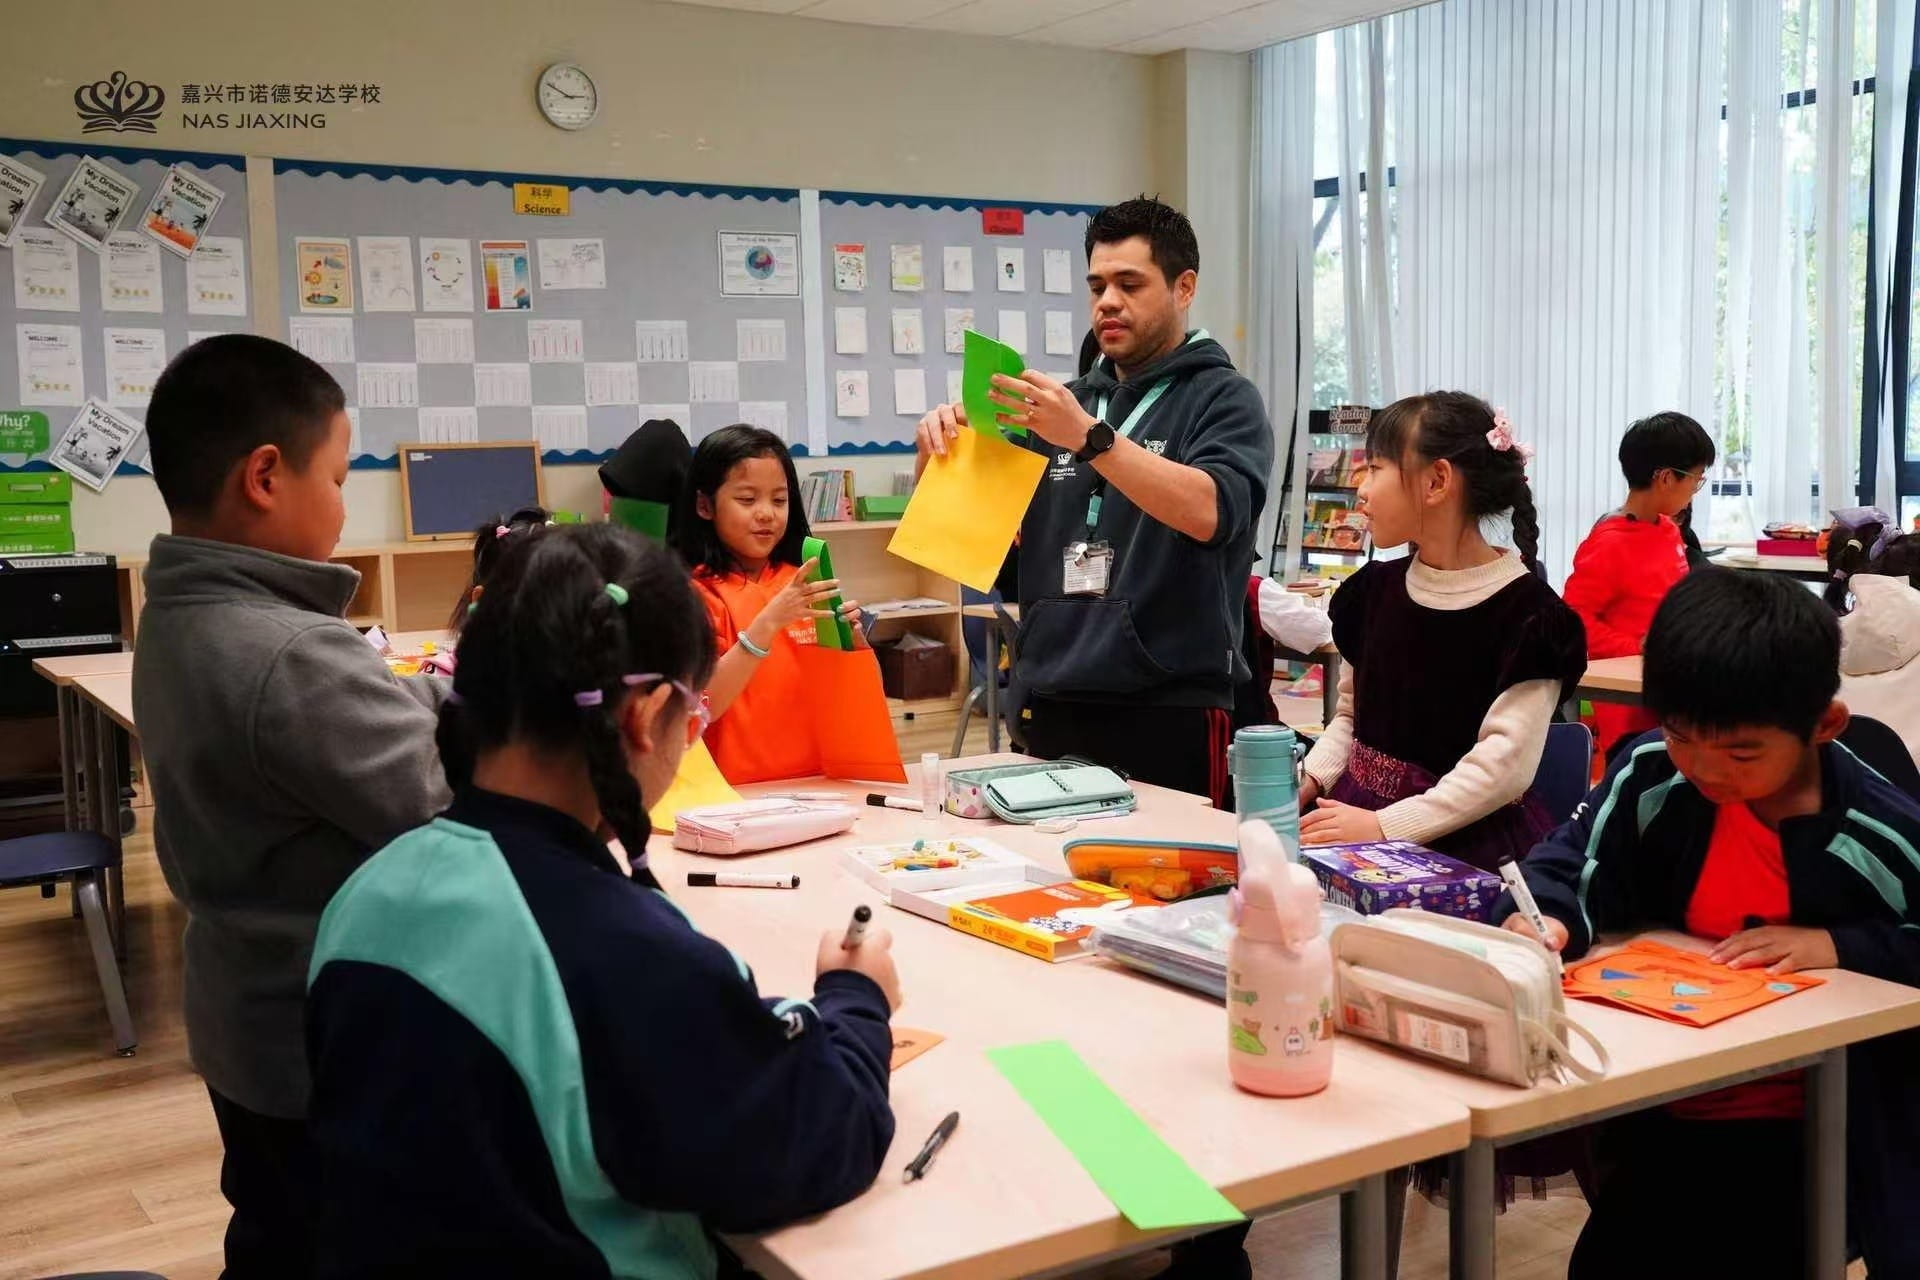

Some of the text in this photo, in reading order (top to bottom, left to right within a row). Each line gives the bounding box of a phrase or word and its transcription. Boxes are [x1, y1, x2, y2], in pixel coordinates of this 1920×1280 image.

[84, 178, 121, 204] Vacation
[86, 168, 126, 197] My Dream
[173, 175, 214, 202] My Dream
[171, 184, 207, 210] Vacation
[524, 203, 562, 215] Science
[88, 418, 122, 442] Vacation
[90, 408, 130, 436] My Dream
